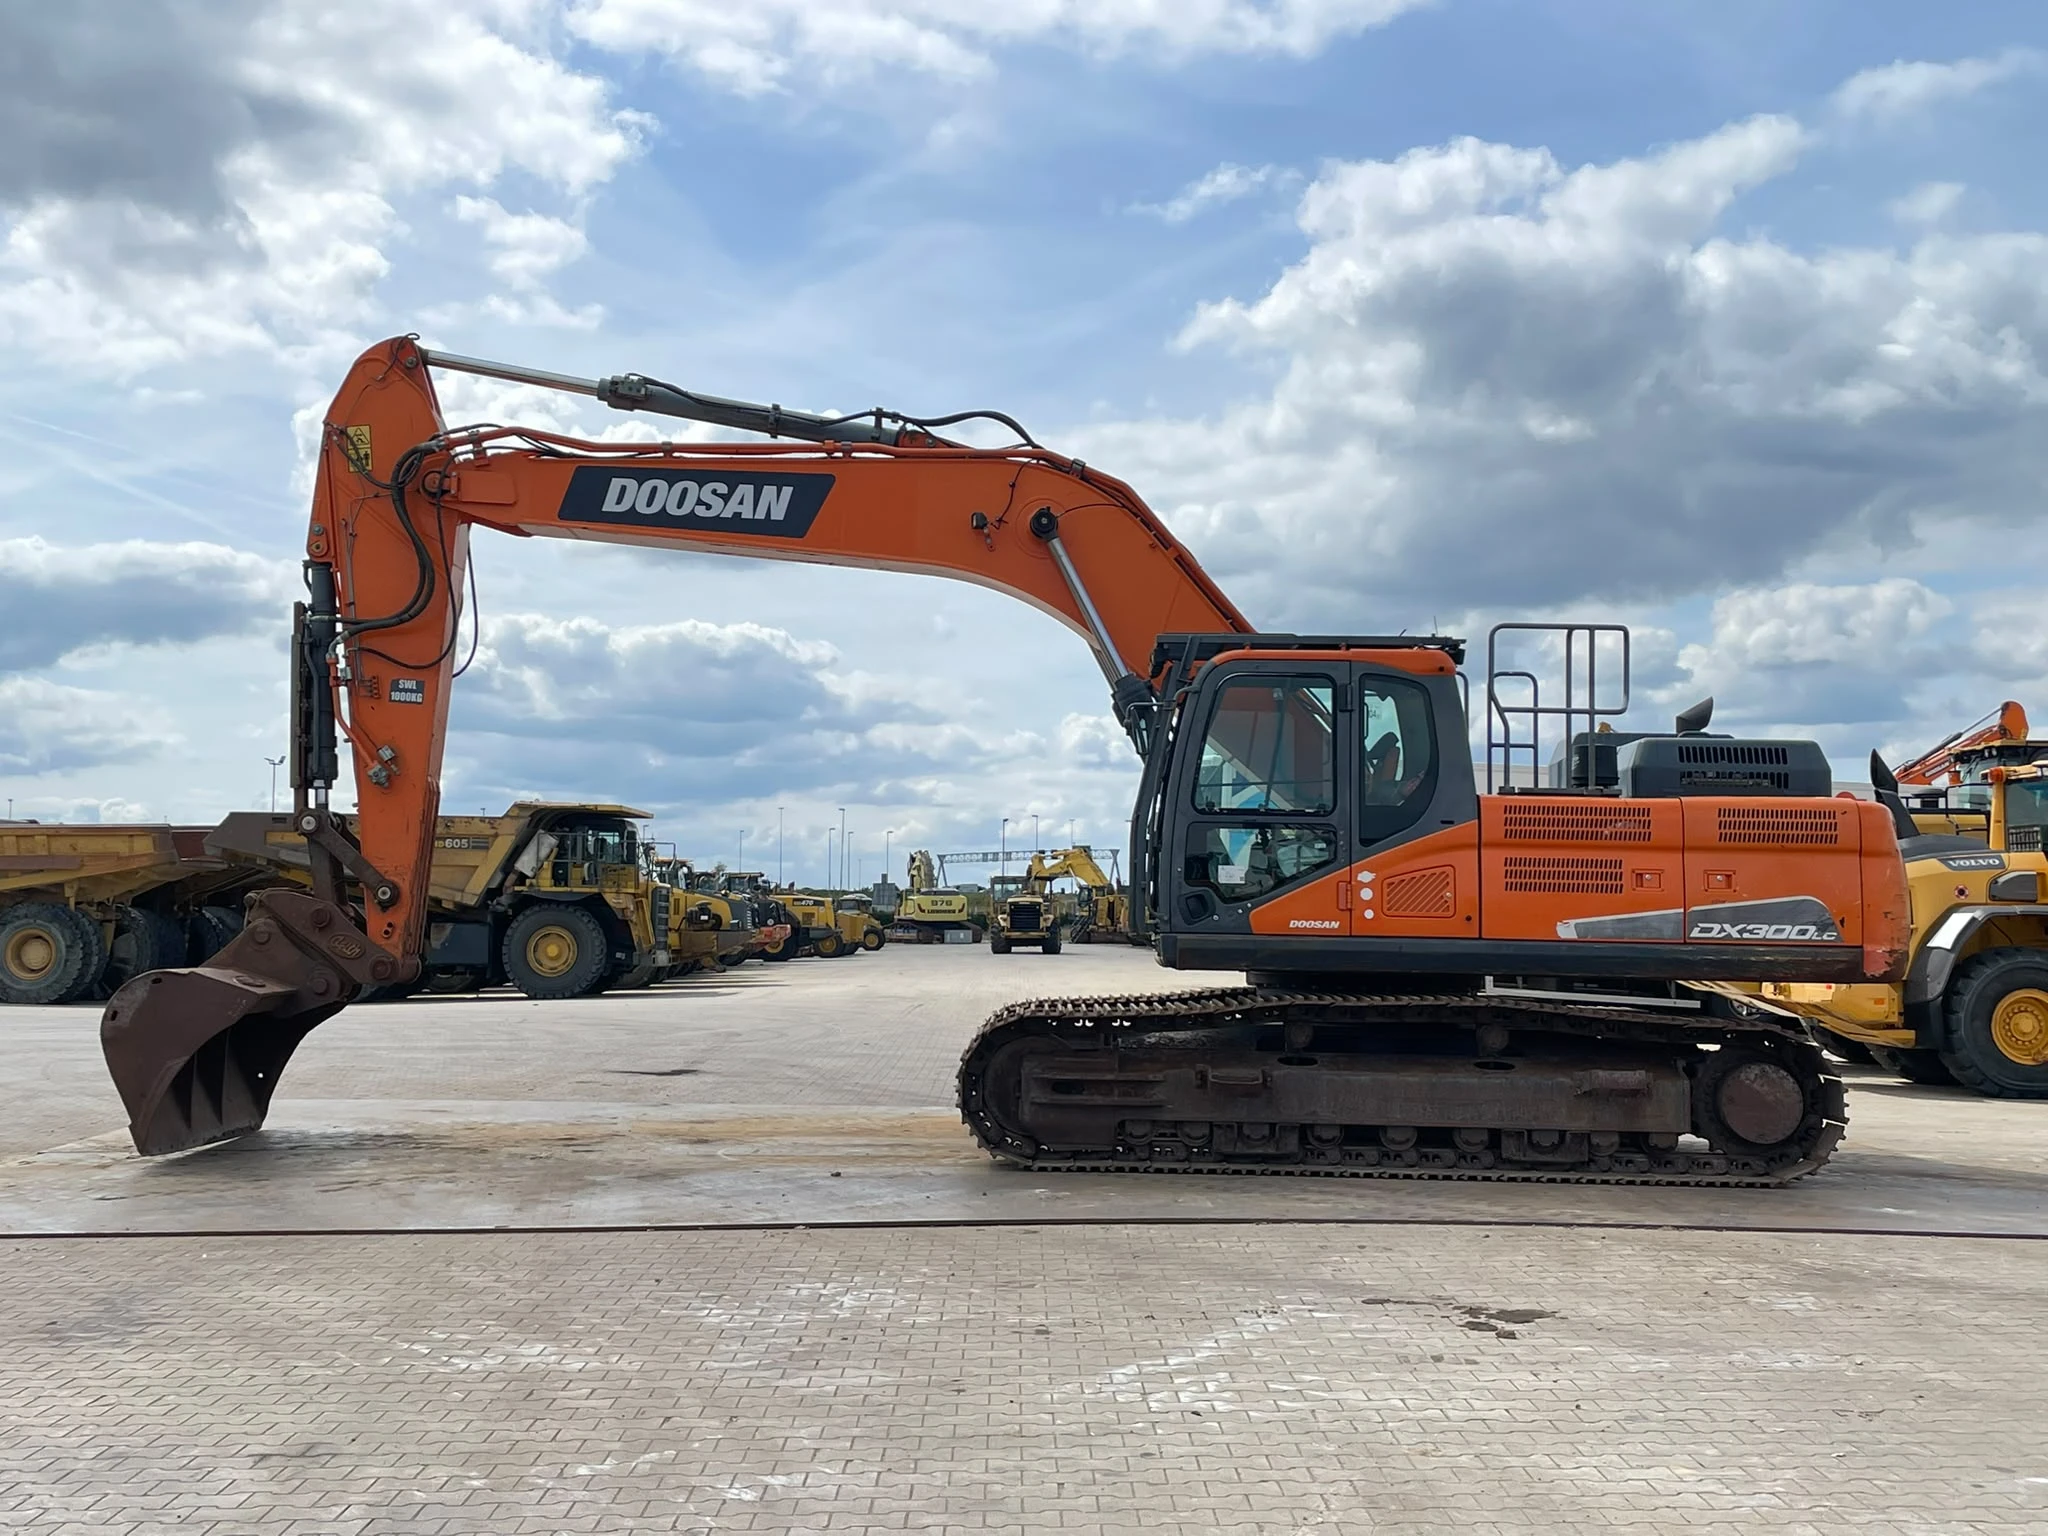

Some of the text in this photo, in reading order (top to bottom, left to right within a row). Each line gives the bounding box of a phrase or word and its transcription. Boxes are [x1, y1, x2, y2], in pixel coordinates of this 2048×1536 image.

[601, 477, 794, 521] DOOSAN
[390, 691, 423, 703] 1000KG
[1947, 858, 2000, 867] VOLVO
[1289, 919, 1340, 929] DOOSAN
